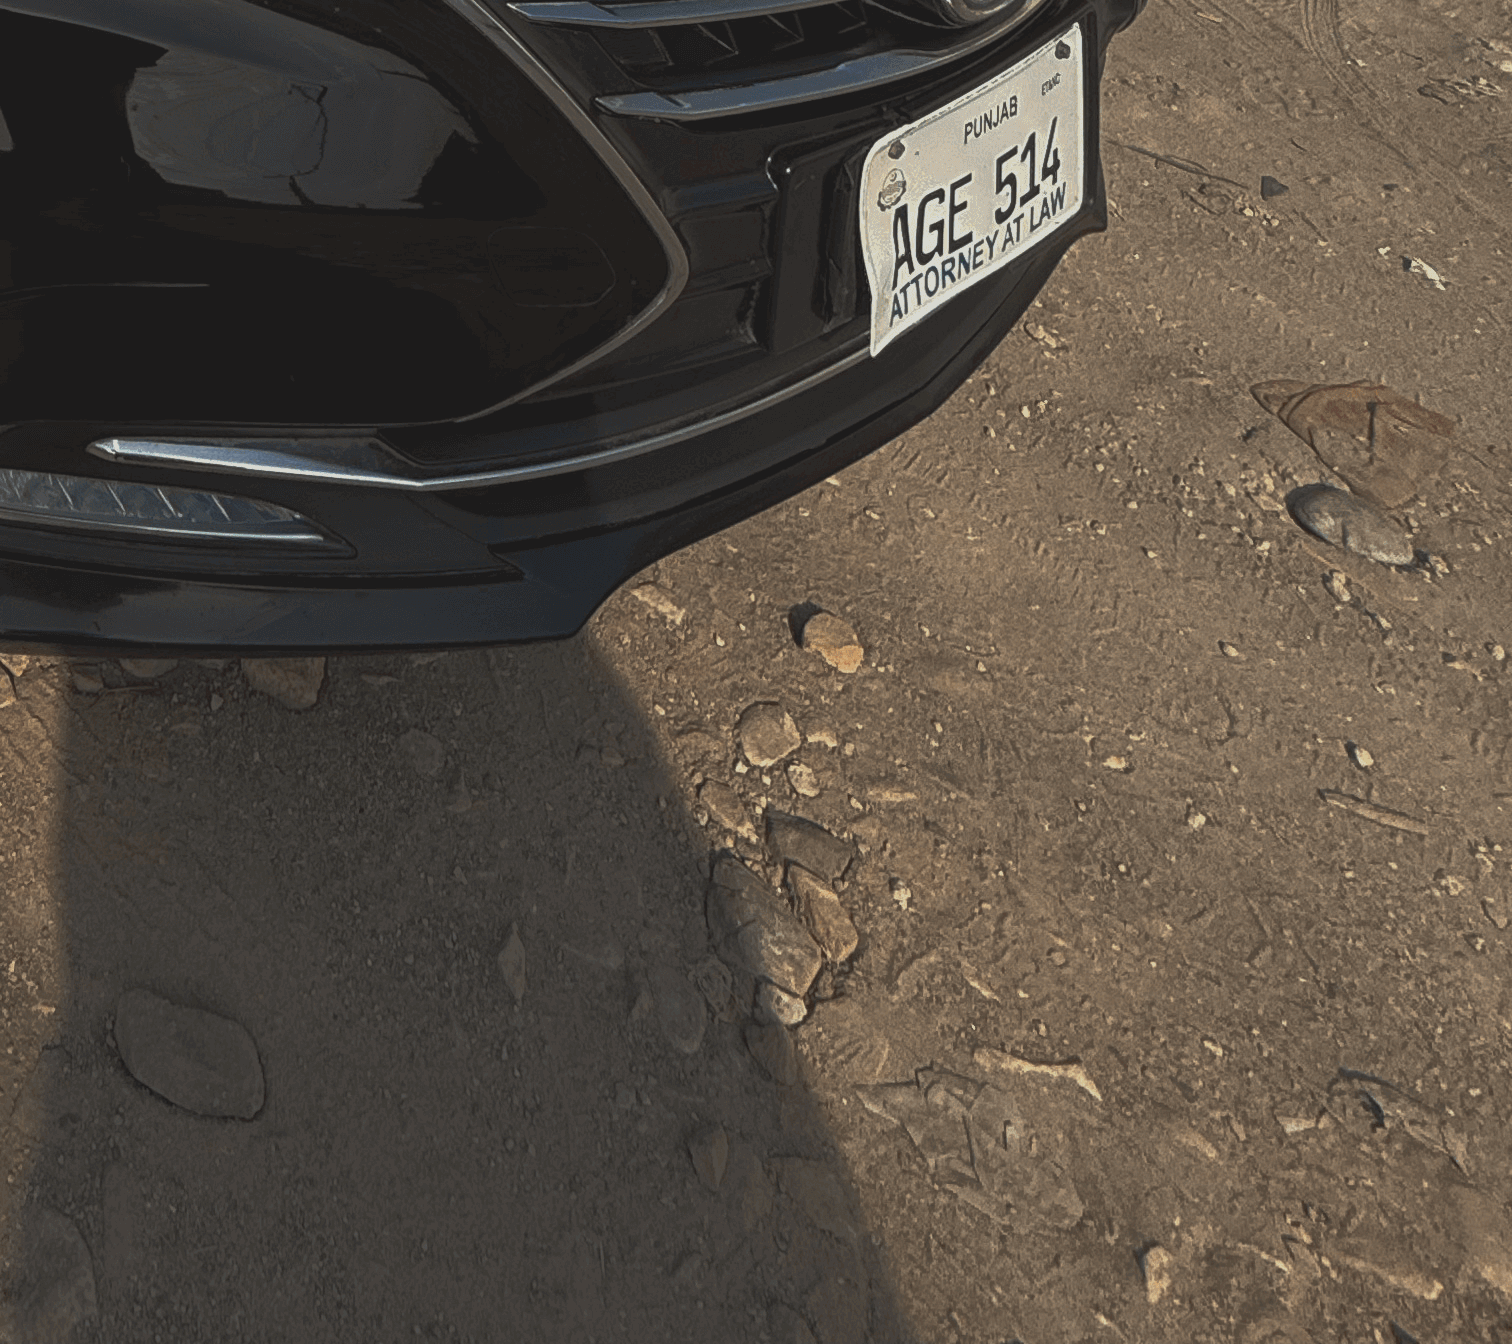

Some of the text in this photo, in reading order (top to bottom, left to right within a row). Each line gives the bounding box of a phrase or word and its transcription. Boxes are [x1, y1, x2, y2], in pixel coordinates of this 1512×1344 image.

[963, 95, 1018, 145] PUNJAB
[889, 181, 1067, 328] ATTORNEY AT LAW
[892, 116, 1061, 291] AGE 514
